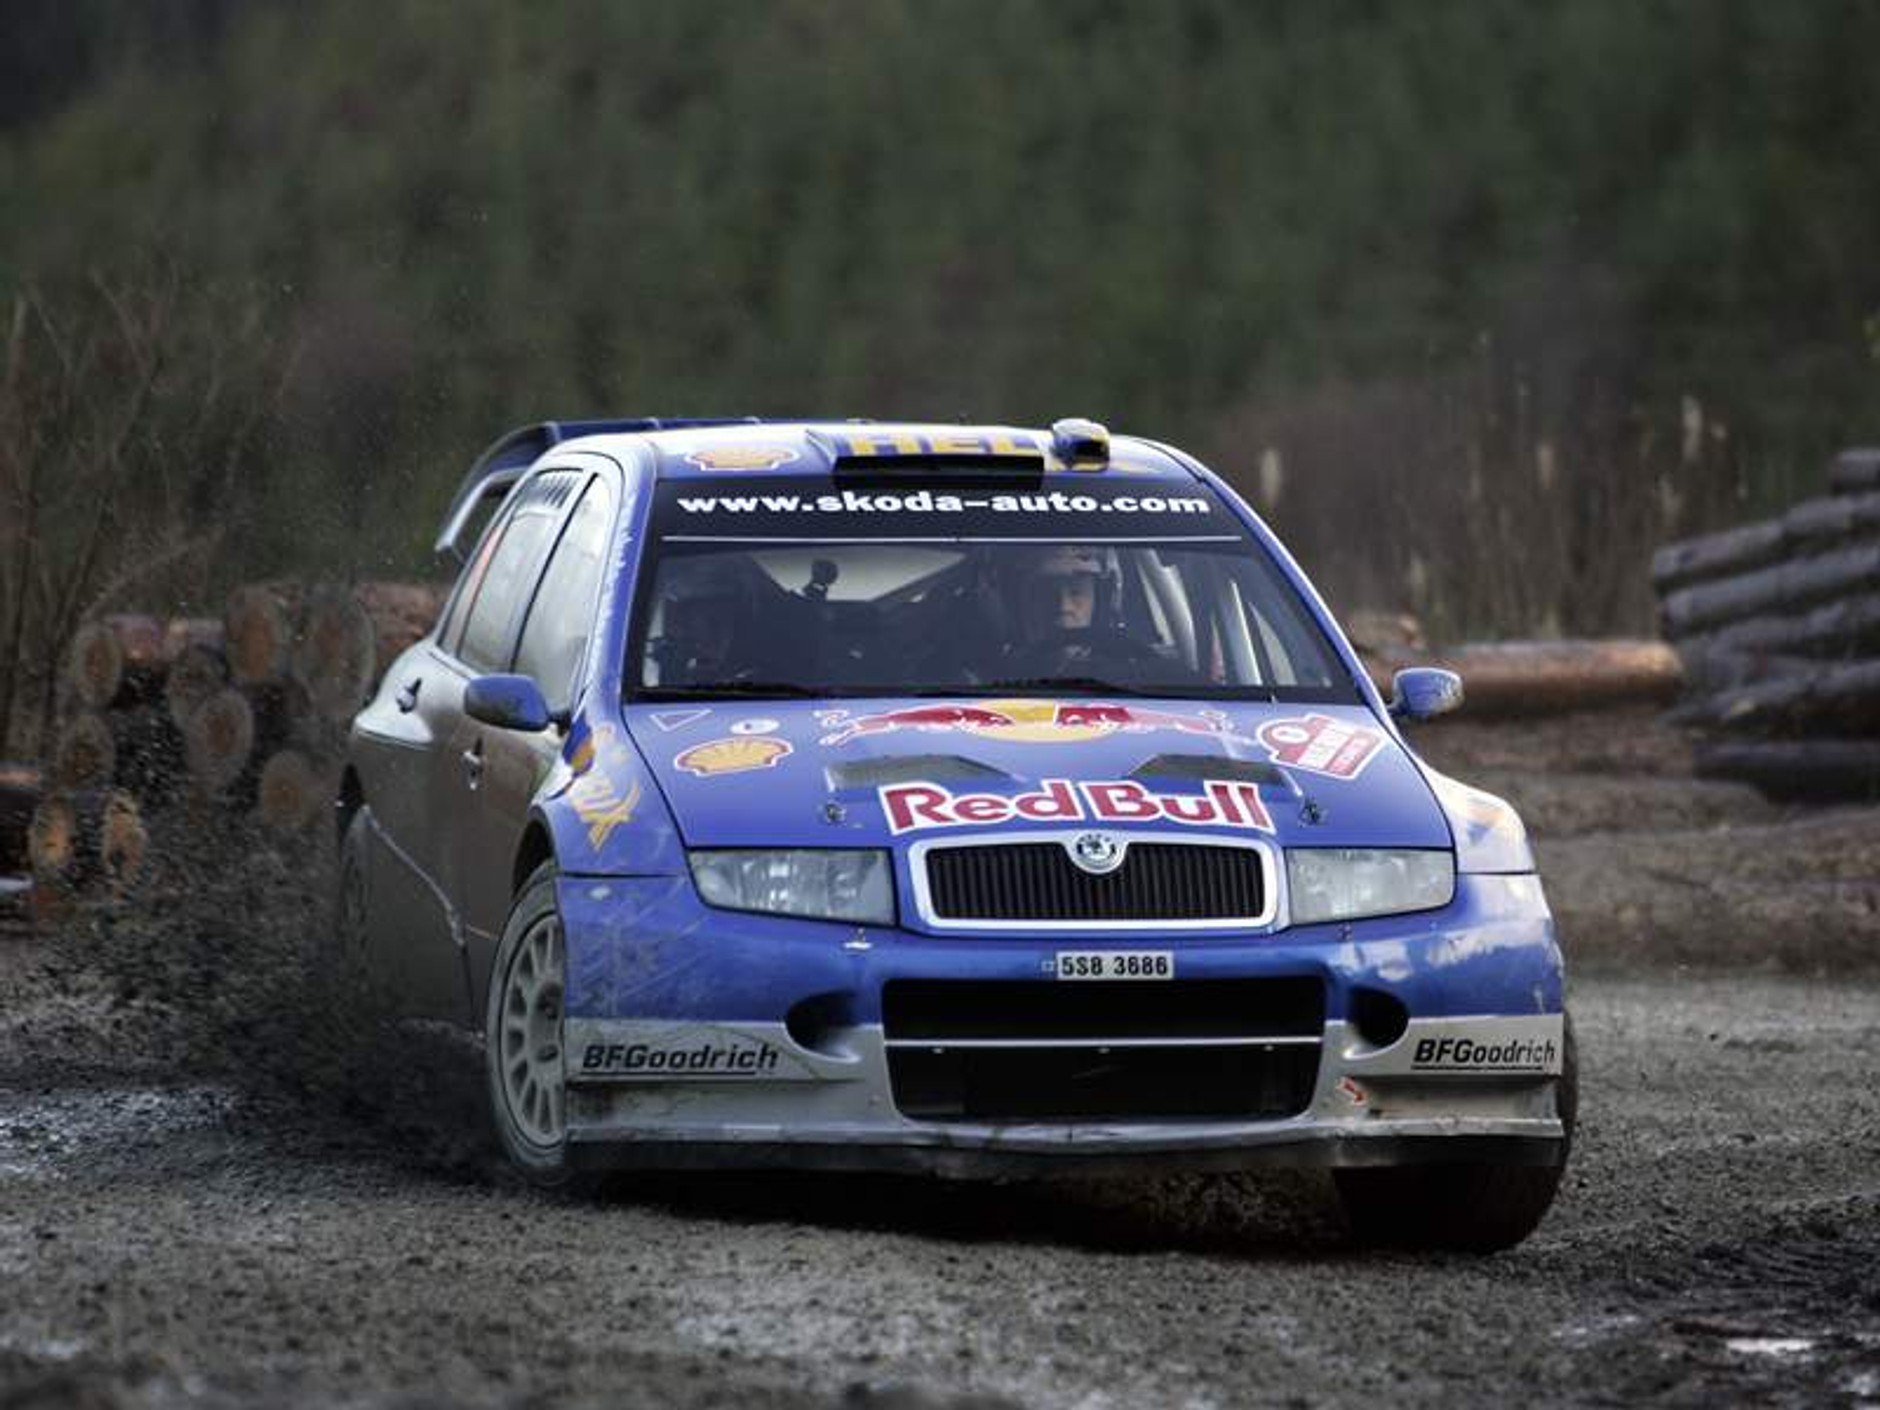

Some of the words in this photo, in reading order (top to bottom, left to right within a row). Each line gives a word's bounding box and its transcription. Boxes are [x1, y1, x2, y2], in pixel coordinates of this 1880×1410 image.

[677, 491, 1211, 514] www.skoda-auto.com
[884, 780, 1084, 833] Red
[1084, 780, 1273, 832] Bull
[582, 1043, 779, 1070] BFGoodrich
[1413, 1038, 1556, 1064] BFGoodrich
